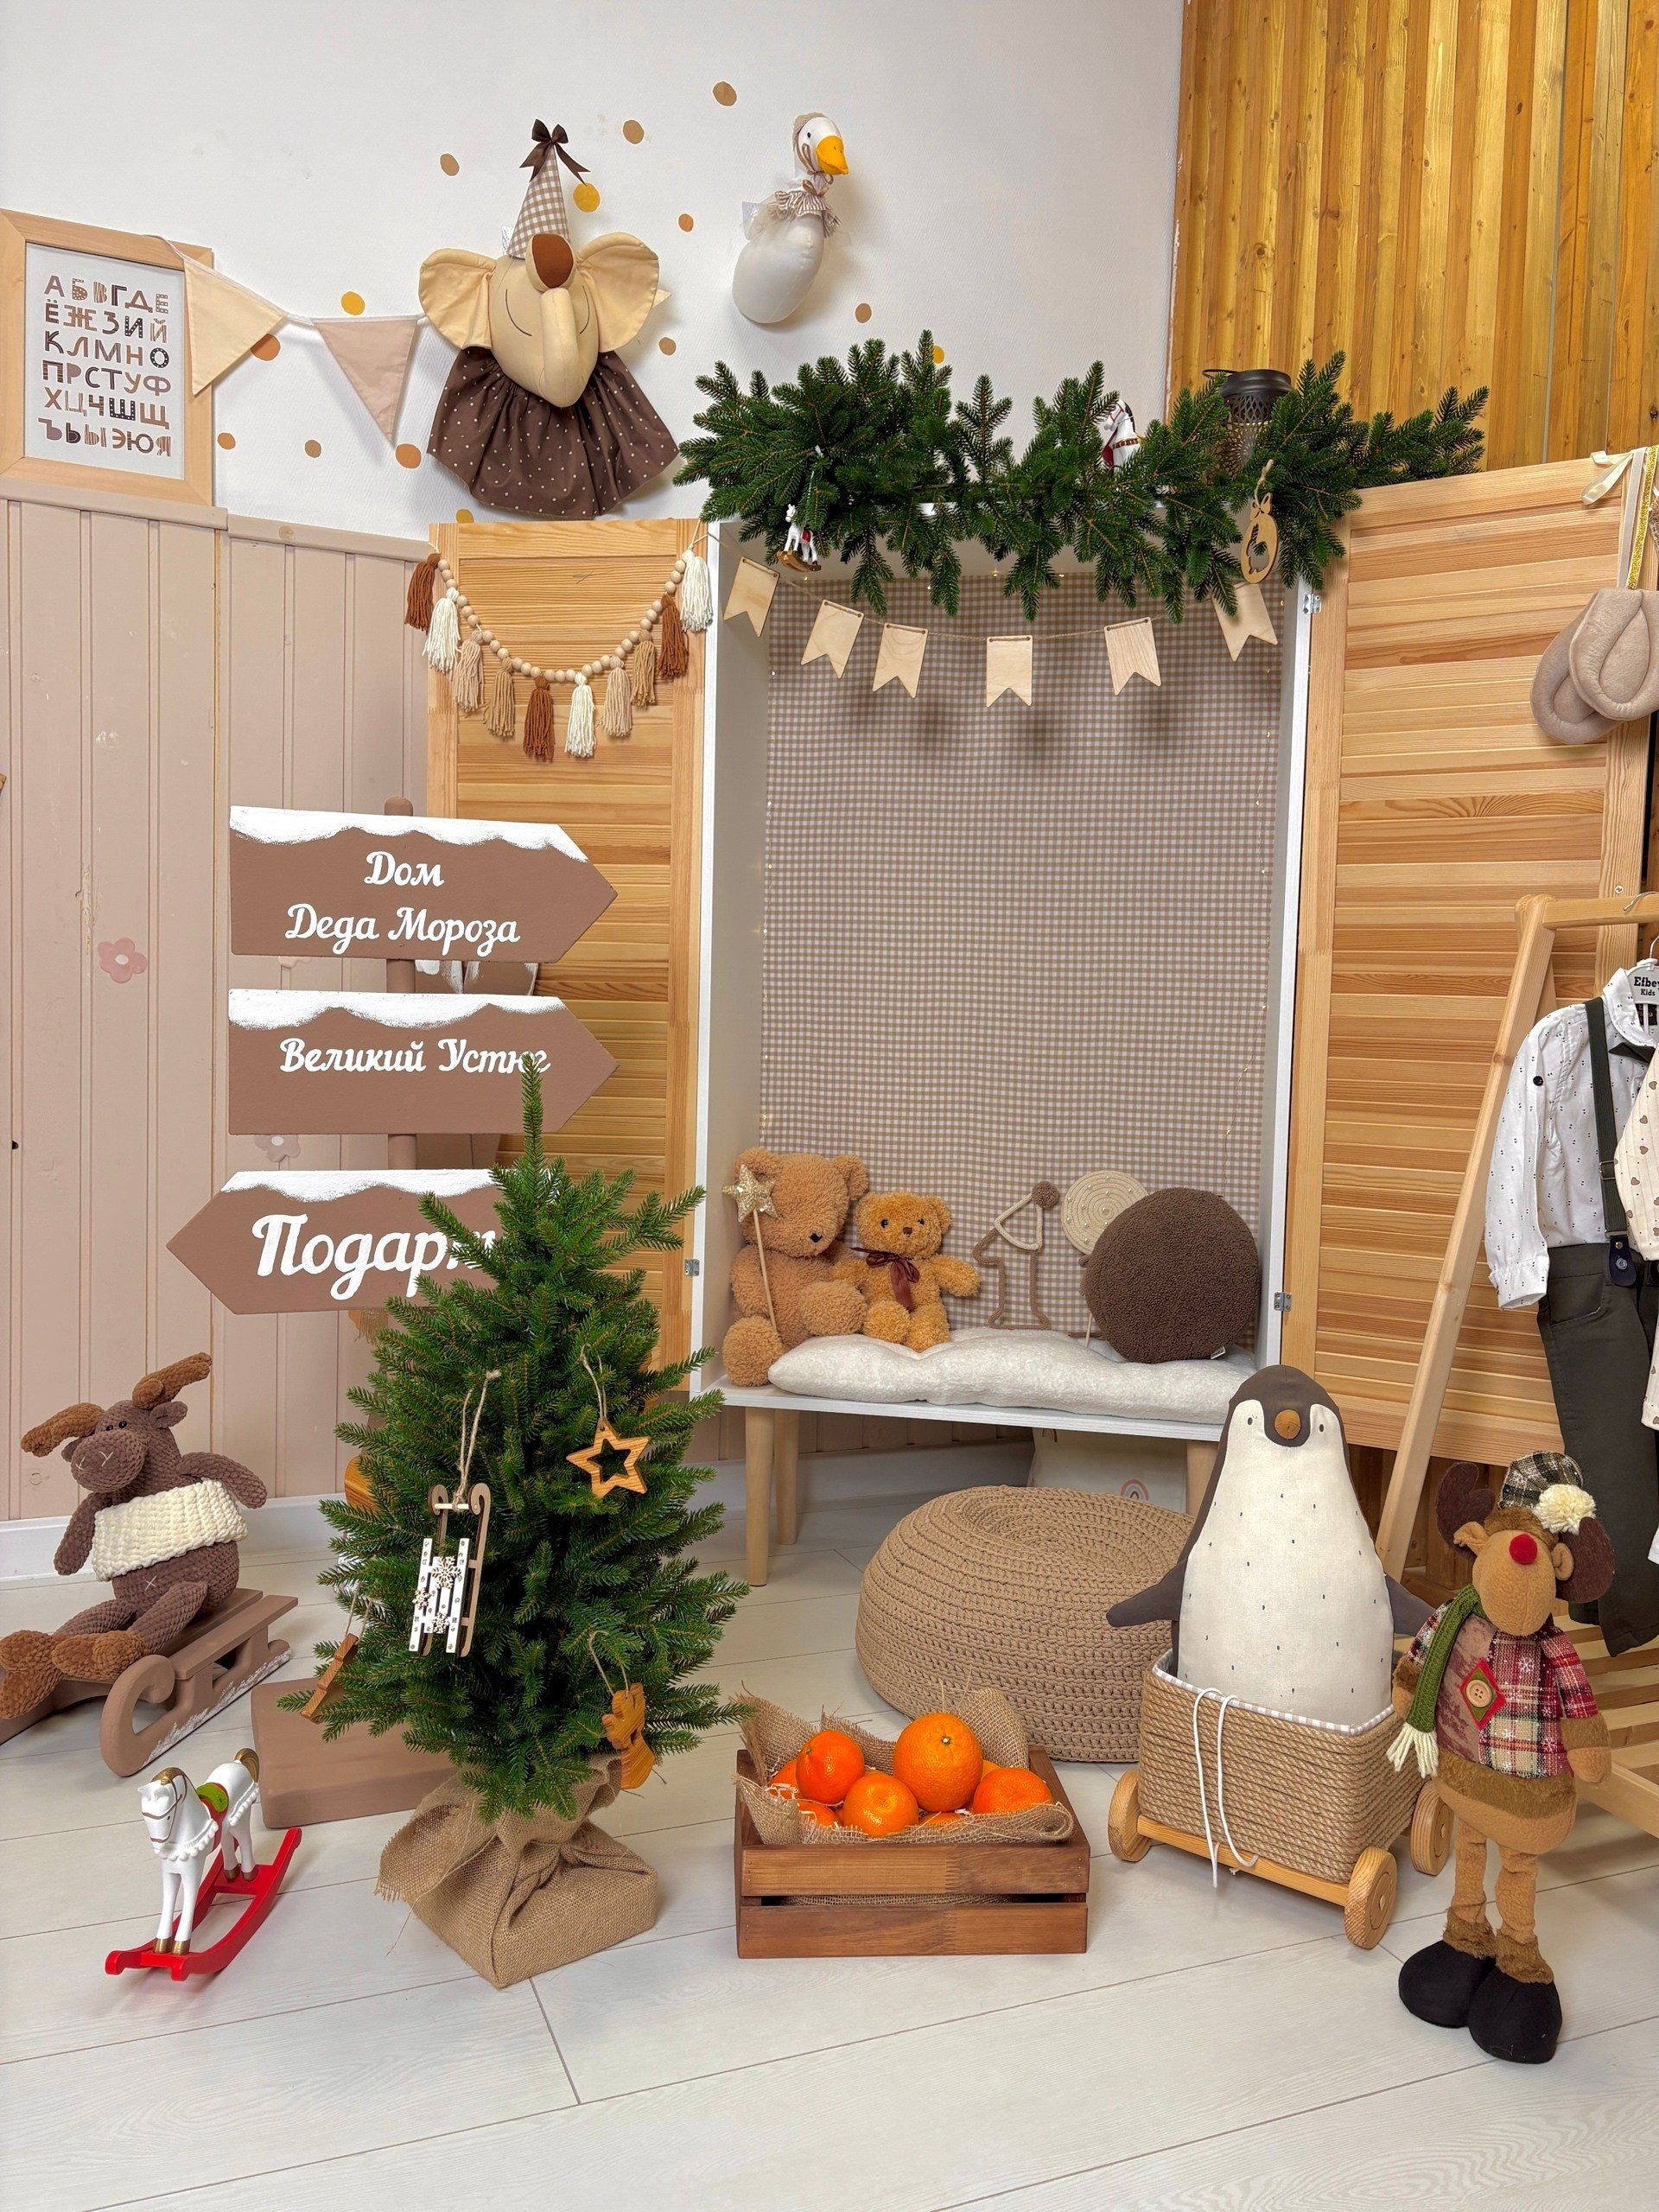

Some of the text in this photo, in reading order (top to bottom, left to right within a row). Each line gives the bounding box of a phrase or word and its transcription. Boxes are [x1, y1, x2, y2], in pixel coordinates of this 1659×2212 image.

[364, 851, 444, 887] Дом
[284, 904, 521, 957] Деда Мороза
[1634, 976, 1659, 990] Efbe
[280, 1038, 426, 1072] Великий
